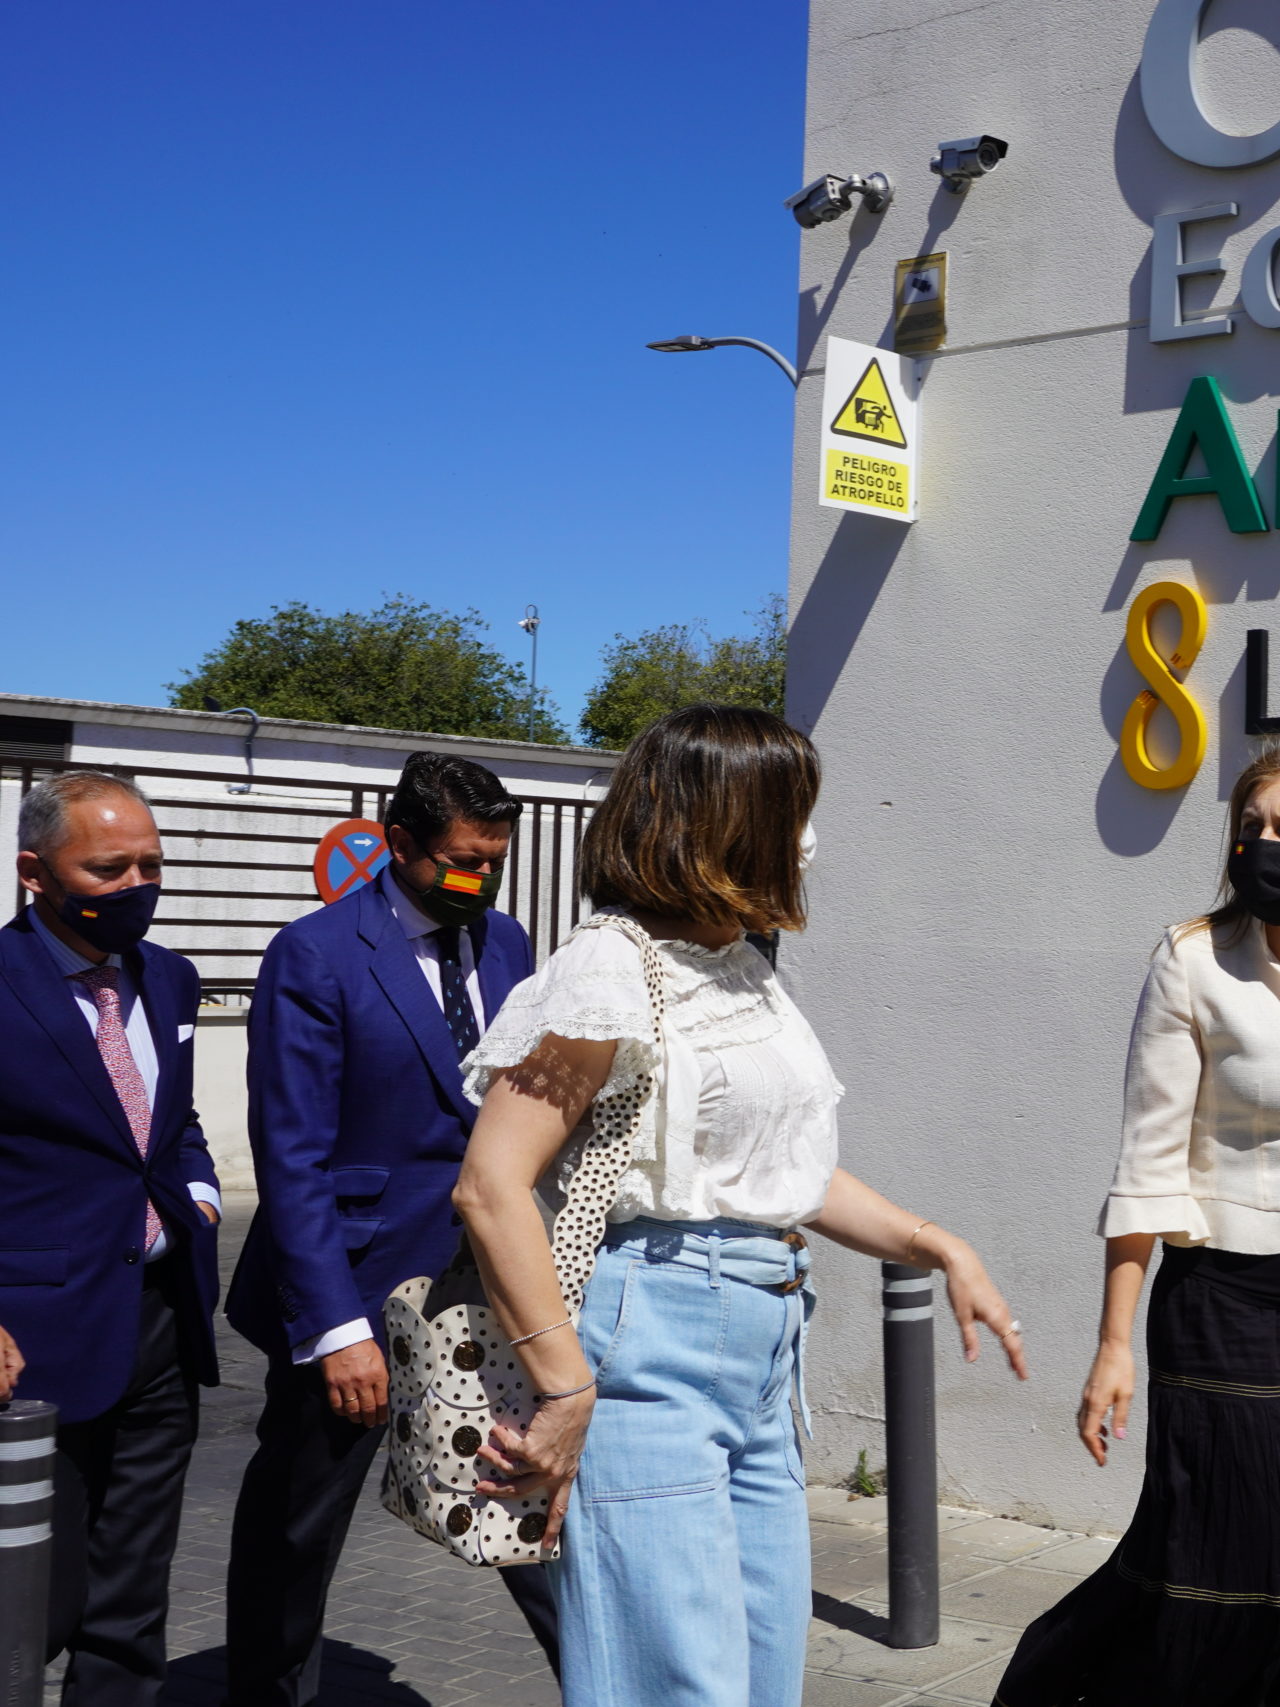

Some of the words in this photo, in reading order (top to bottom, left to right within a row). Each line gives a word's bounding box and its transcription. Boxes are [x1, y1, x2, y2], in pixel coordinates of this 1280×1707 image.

[842, 456, 897, 477] PELIGRO
[835, 469, 884, 489] RIESGO
[887, 479, 903, 493] DE
[831, 484, 905, 508] ATROPELLO
